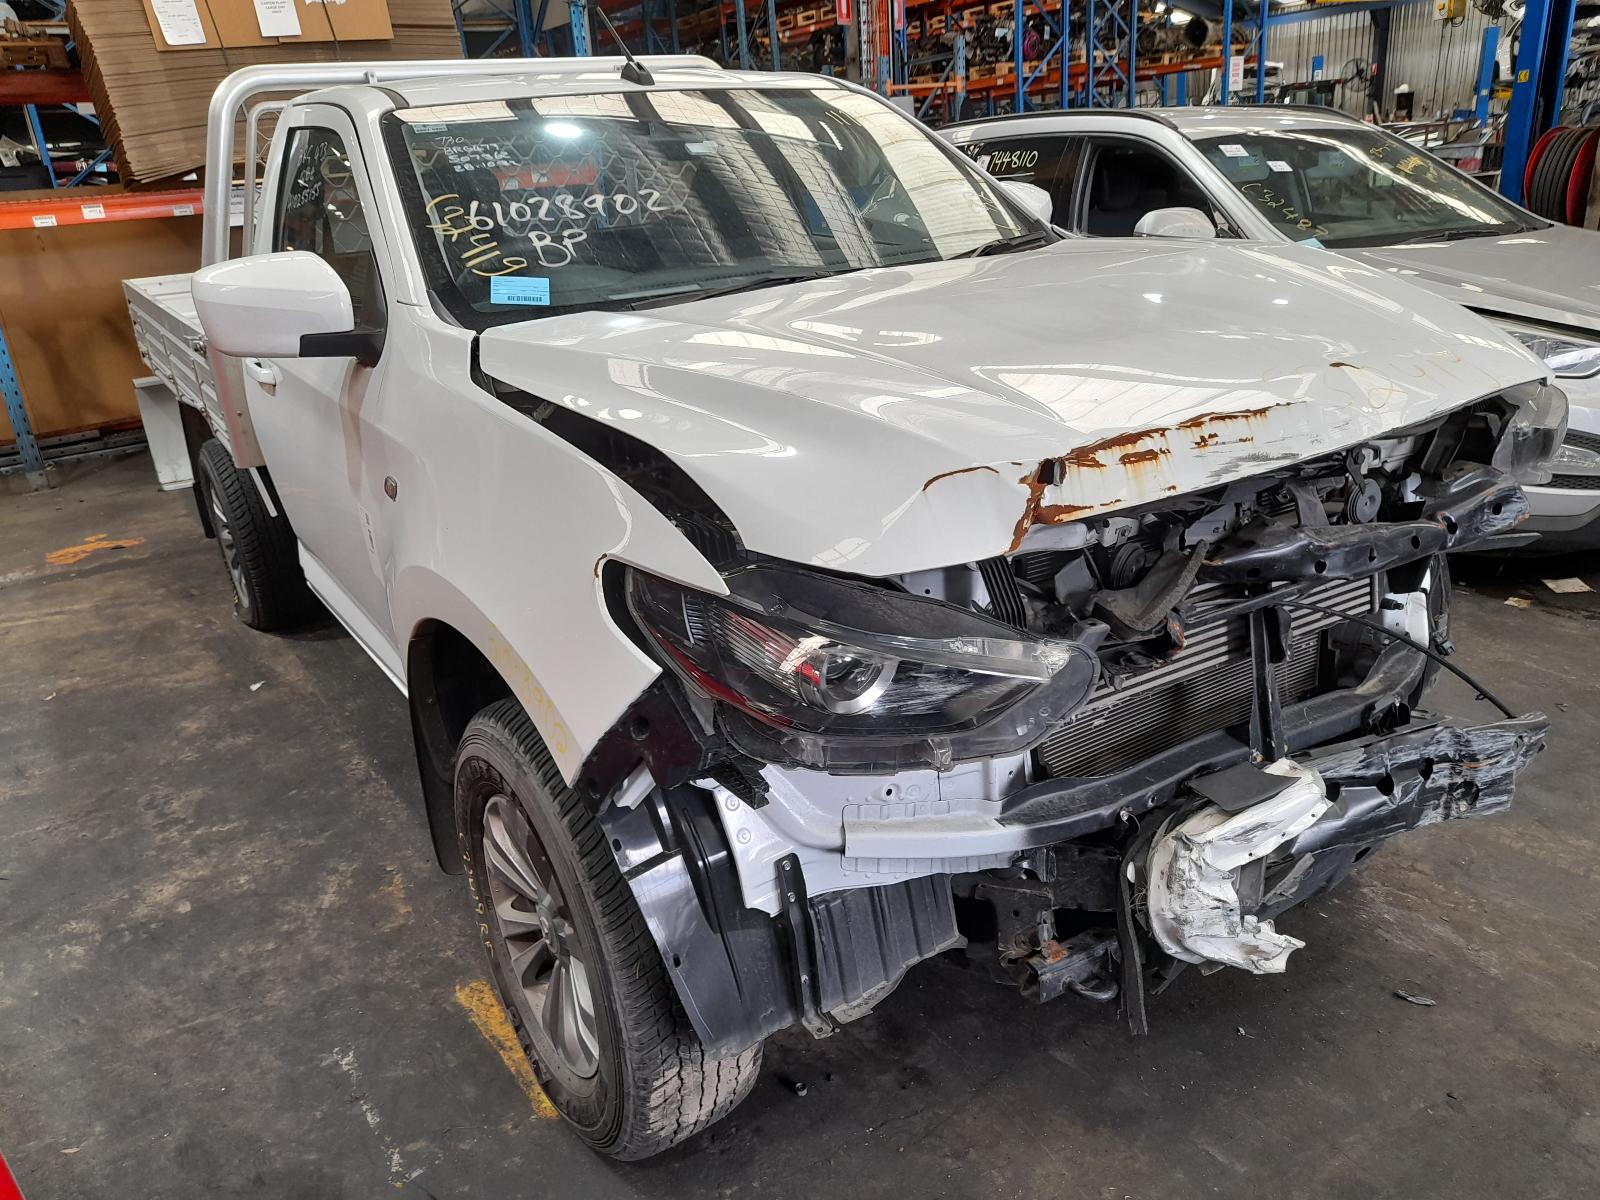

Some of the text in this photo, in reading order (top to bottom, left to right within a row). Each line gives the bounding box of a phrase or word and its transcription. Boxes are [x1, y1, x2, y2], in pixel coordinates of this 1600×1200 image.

[988, 150, 1039, 172] 7448110
[464, 189, 671, 231] 61028902
[528, 228, 588, 268] BP
